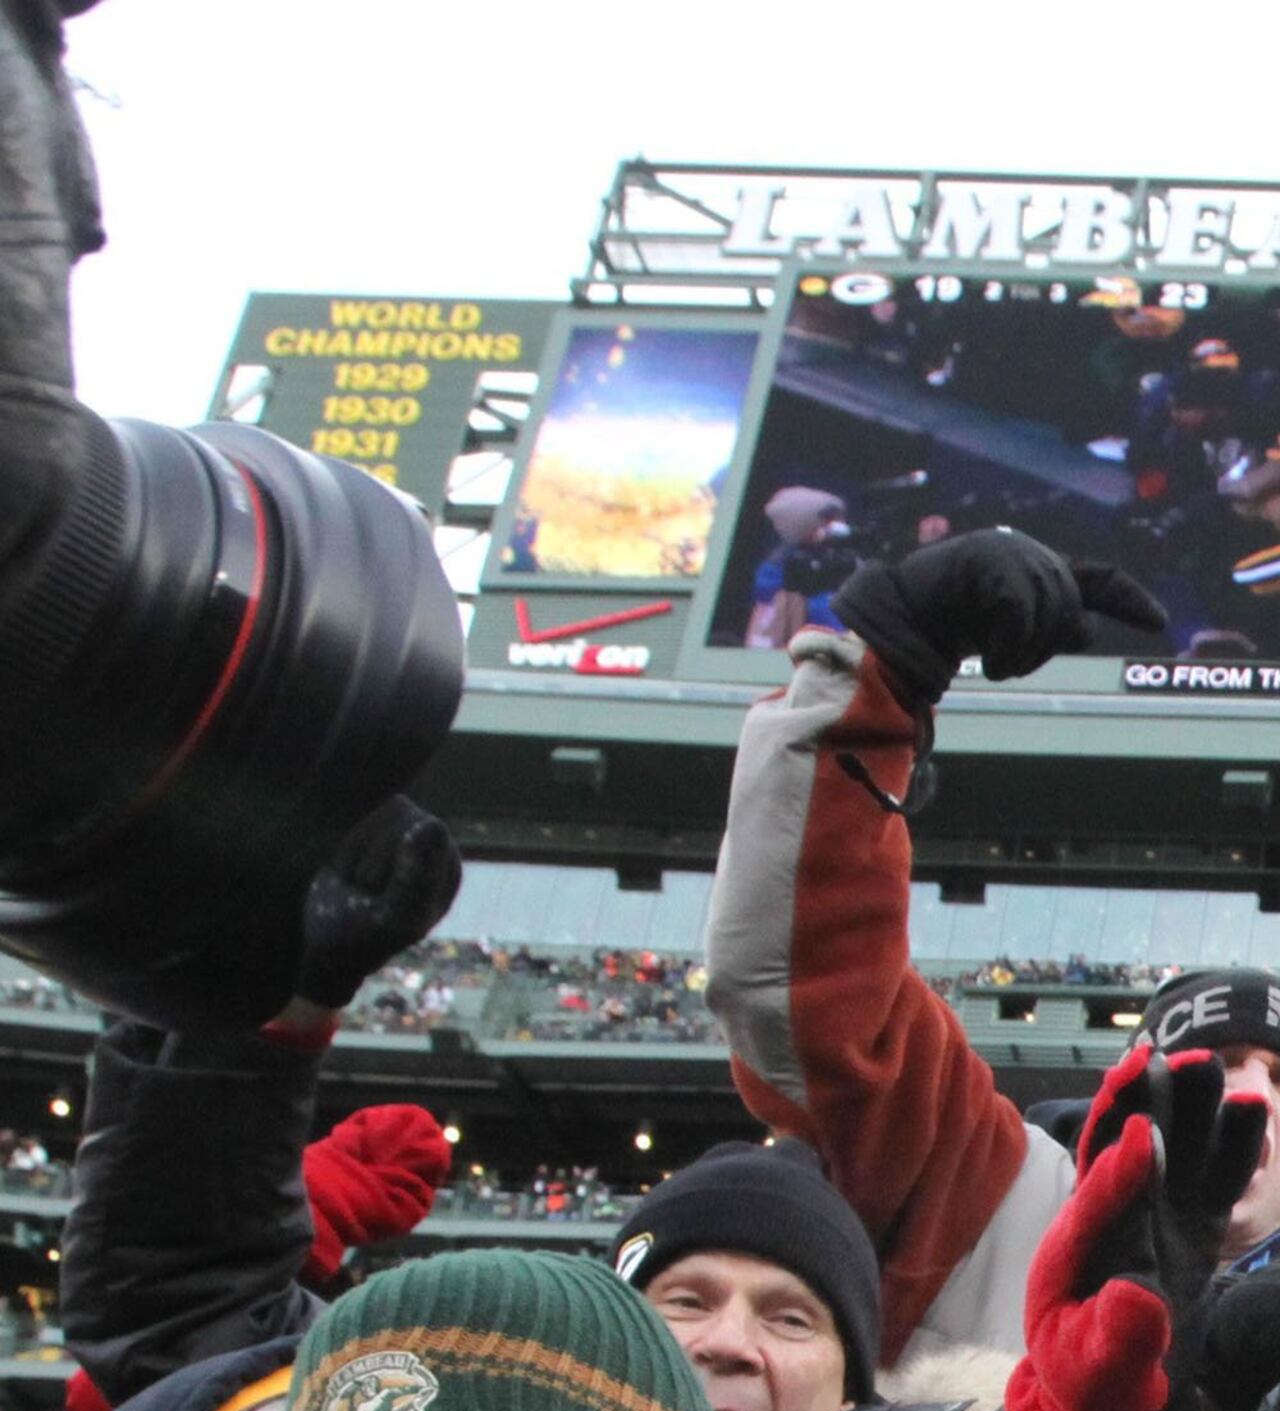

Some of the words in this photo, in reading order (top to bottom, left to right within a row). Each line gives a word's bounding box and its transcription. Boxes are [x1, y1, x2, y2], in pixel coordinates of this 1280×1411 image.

[915, 275, 963, 302] 19
[1159, 282, 1208, 309] 23
[330, 301, 481, 330] WORLD
[265, 327, 522, 361] CHAMPIONS
[335, 362, 430, 391] 1929
[323, 396, 422, 425] 1930
[313, 428, 399, 458] 1931
[508, 638, 650, 676] verizon
[1126, 664, 1168, 687] GO
[1172, 665, 1251, 689] FROM
